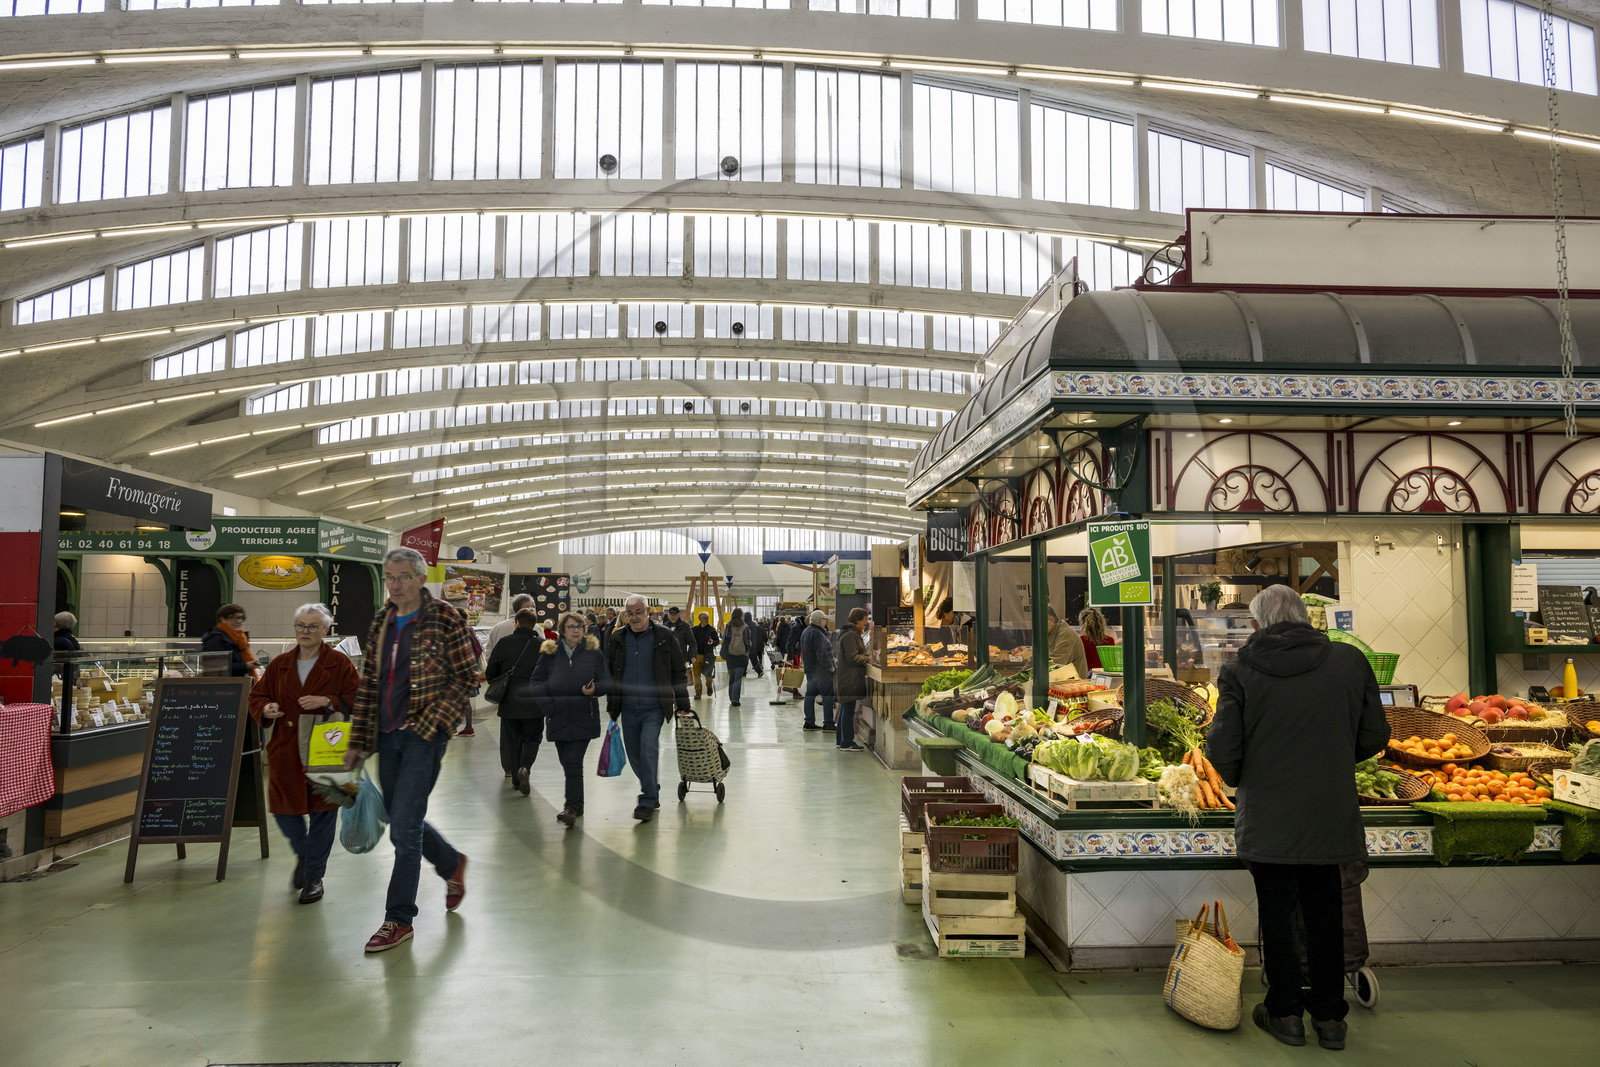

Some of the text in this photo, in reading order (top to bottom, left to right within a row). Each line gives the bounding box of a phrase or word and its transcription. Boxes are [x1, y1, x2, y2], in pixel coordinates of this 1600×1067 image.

[105, 477, 182, 514] Fromagerie
[221, 526, 316, 535] PRODUCTEUR AGREE
[1102, 524, 1134, 532] PRODUITS
[1136, 523, 1149, 531] BIO
[78, 540, 93, 549] 02
[98, 540, 113, 549] 40
[119, 540, 132, 549] 61
[137, 540, 152, 549] 94
[158, 541, 171, 549] 18
[241, 537, 284, 545] TERROIRS
[1101, 546, 1129, 573] AB
[841, 568, 854, 578] AB
[1101, 564, 1138, 579] AGRICULTURE
[1102, 569, 1140, 584] BIOLOGIQUE
